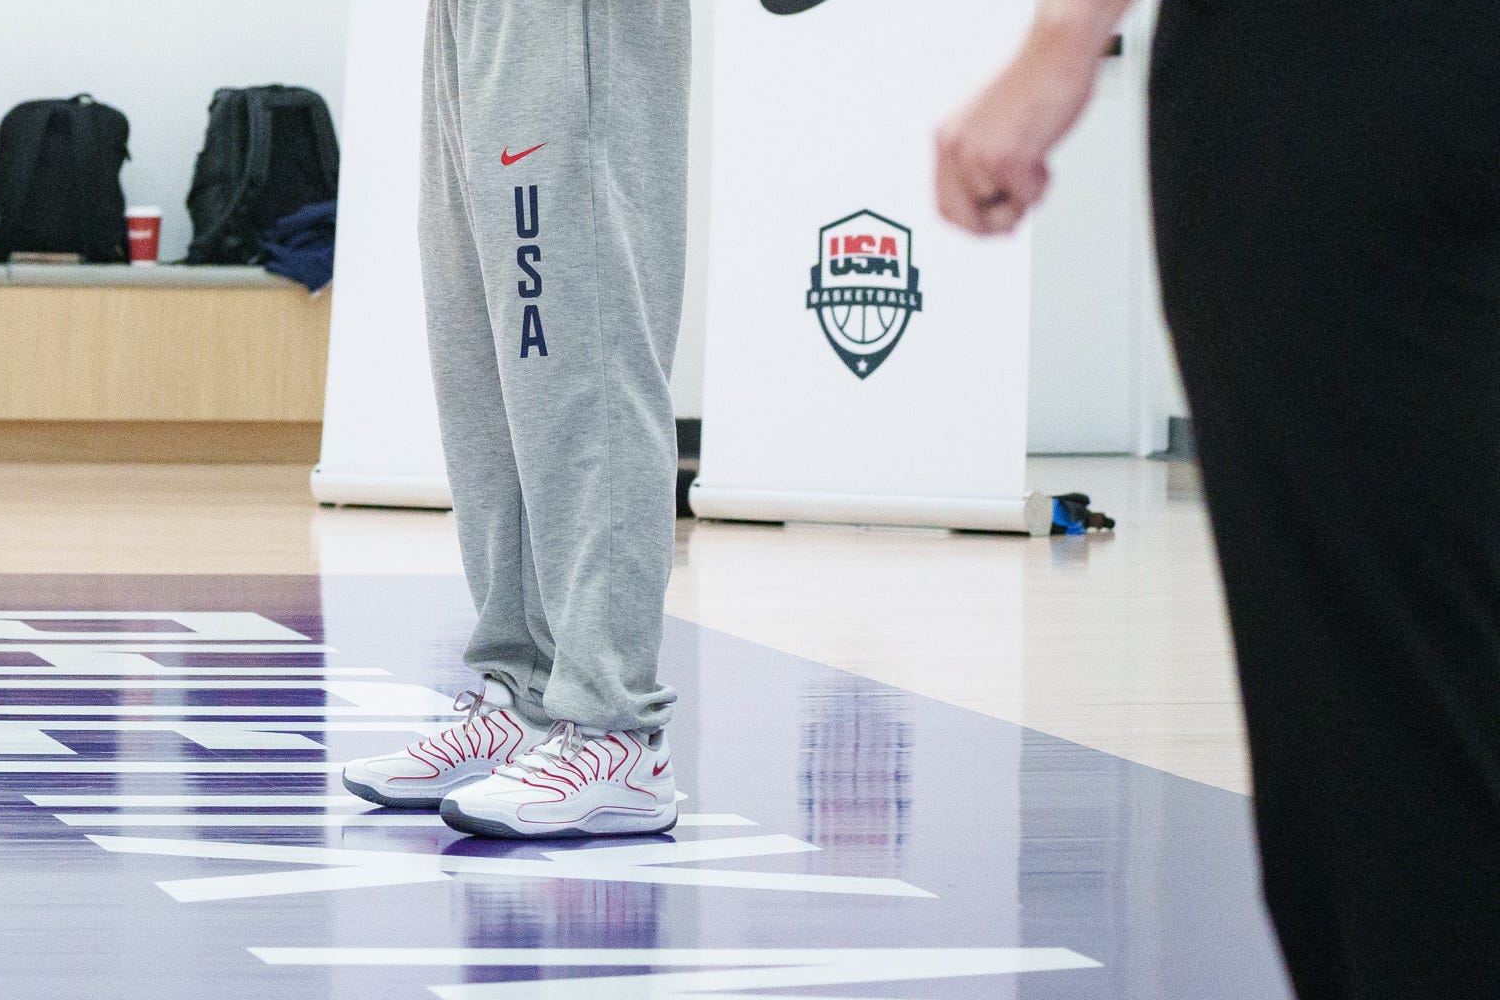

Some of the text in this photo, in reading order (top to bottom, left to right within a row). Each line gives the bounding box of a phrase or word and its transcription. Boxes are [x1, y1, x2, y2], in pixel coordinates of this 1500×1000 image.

[514, 184, 548, 358] USA
[830, 235, 900, 278] USA
[810, 289, 918, 305] BASKETBALL
